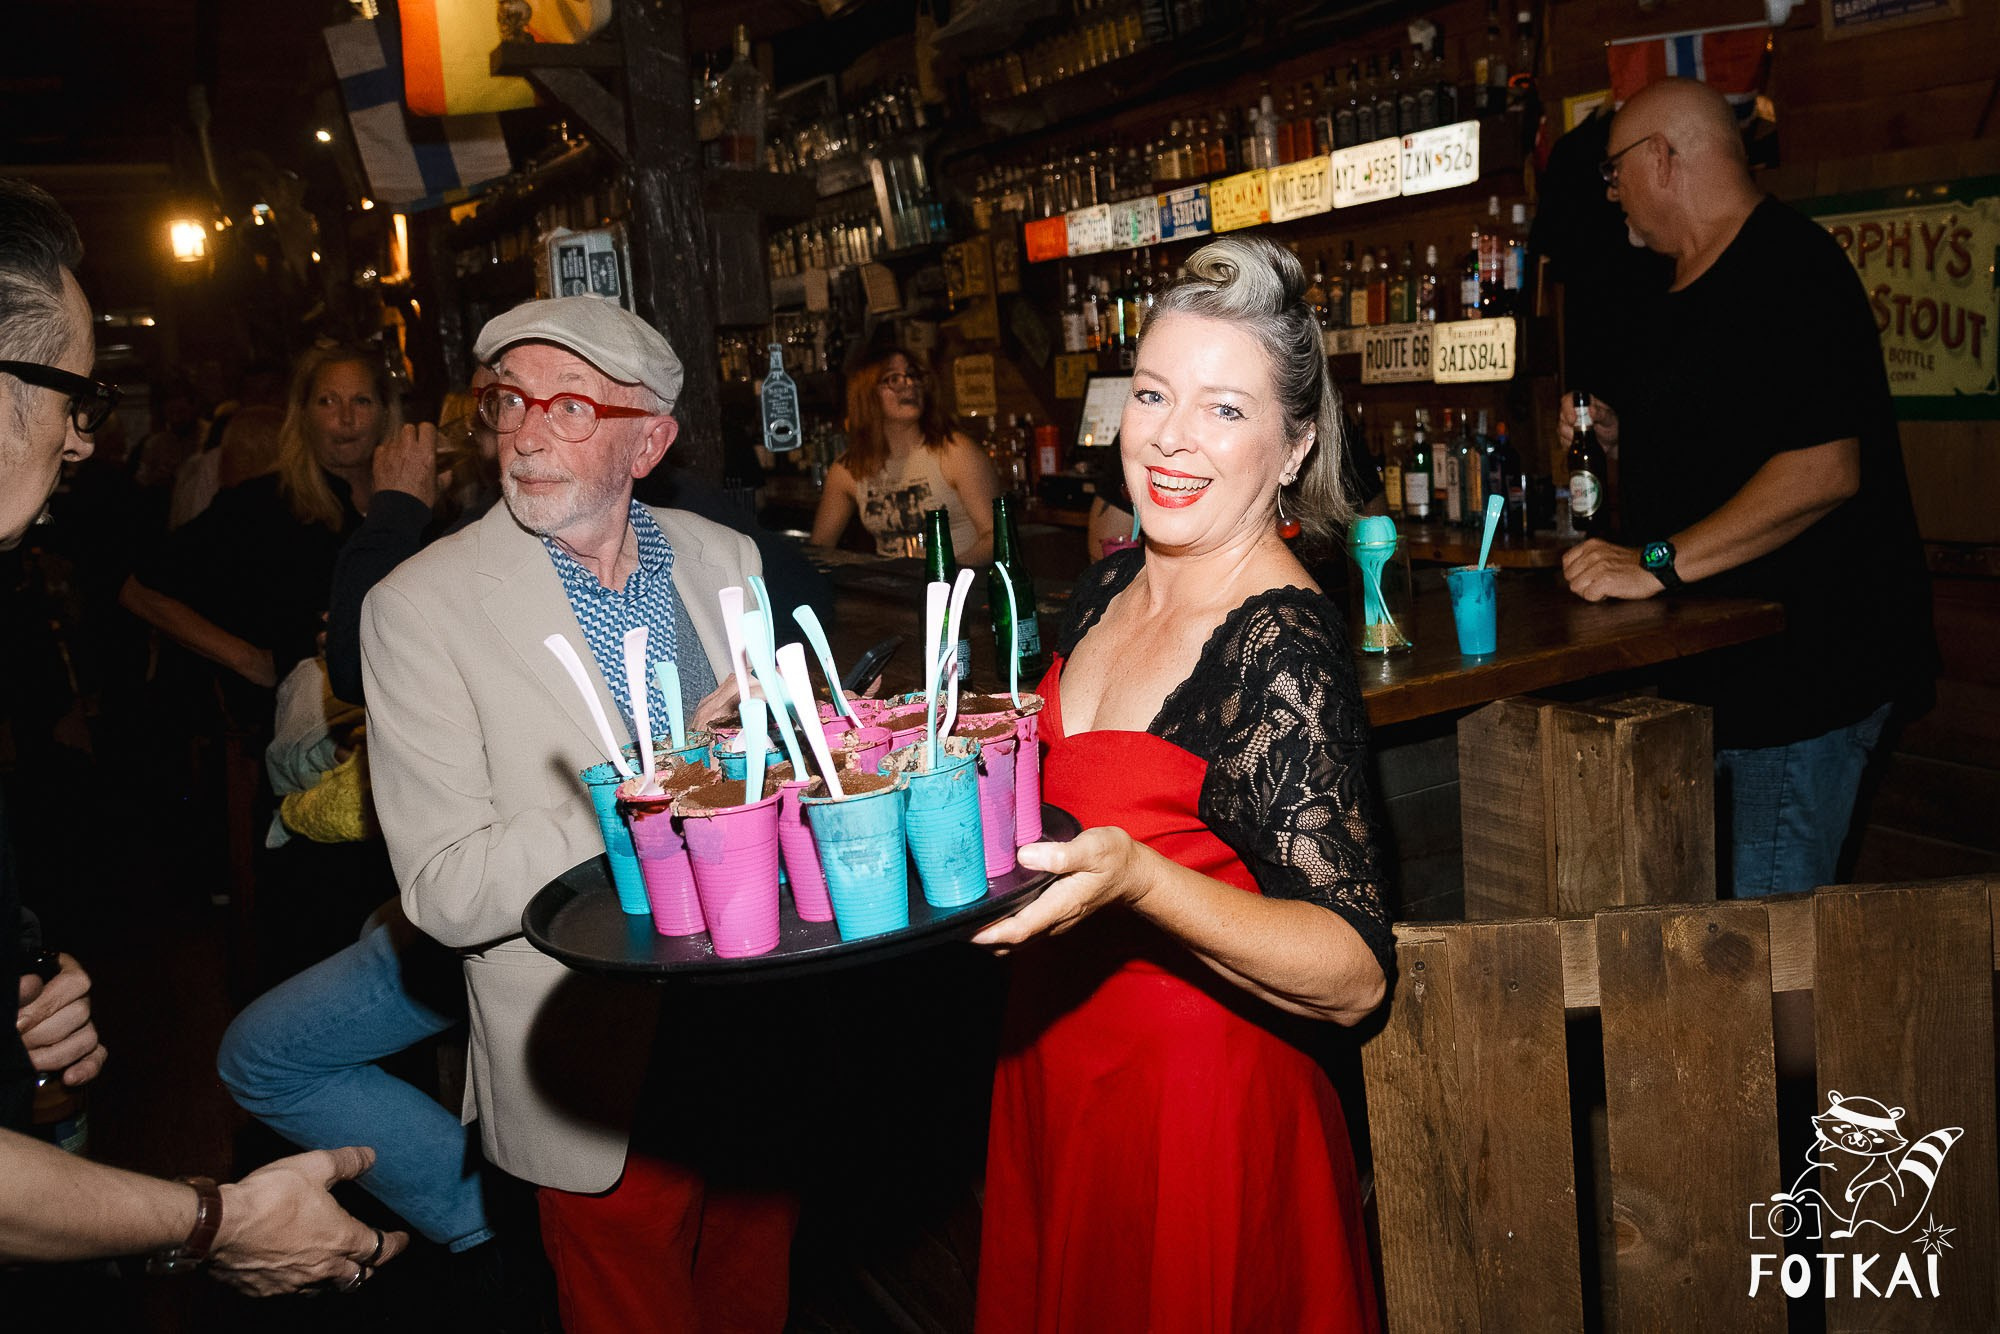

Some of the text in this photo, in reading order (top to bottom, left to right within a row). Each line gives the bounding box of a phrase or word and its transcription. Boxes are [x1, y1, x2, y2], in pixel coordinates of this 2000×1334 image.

[1443, 141, 1472, 172] 526
[1871, 284, 1986, 359] STOUT
[1366, 337, 1408, 370] ROUTE
[1412, 335, 1430, 368] 66
[1439, 342, 1508, 372] 3AIS841
[1889, 347, 1935, 371] BOTTLE
